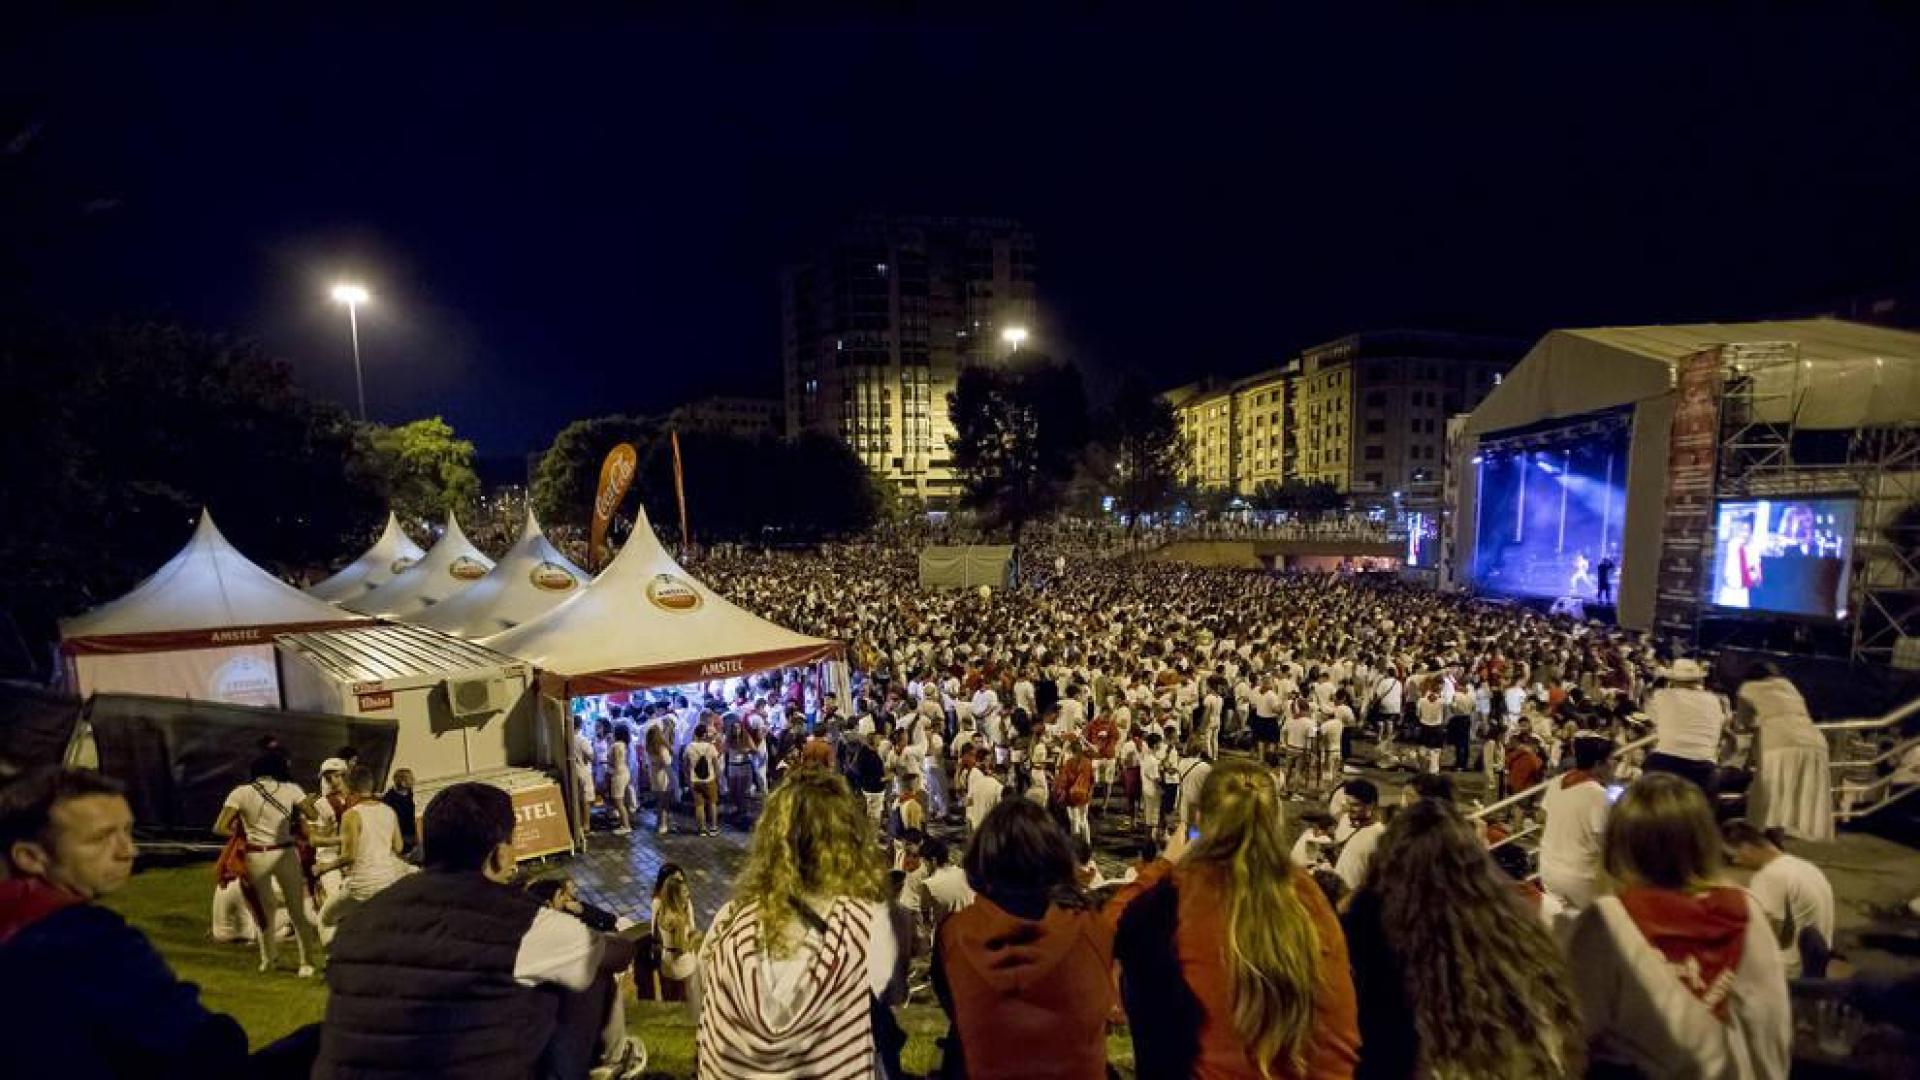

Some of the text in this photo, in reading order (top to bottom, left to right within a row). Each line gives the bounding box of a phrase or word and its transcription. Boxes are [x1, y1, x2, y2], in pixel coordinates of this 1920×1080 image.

[211, 629, 260, 642] AMSTEL
[701, 660, 744, 676] AMSTEL
[515, 800, 557, 823] STEL
